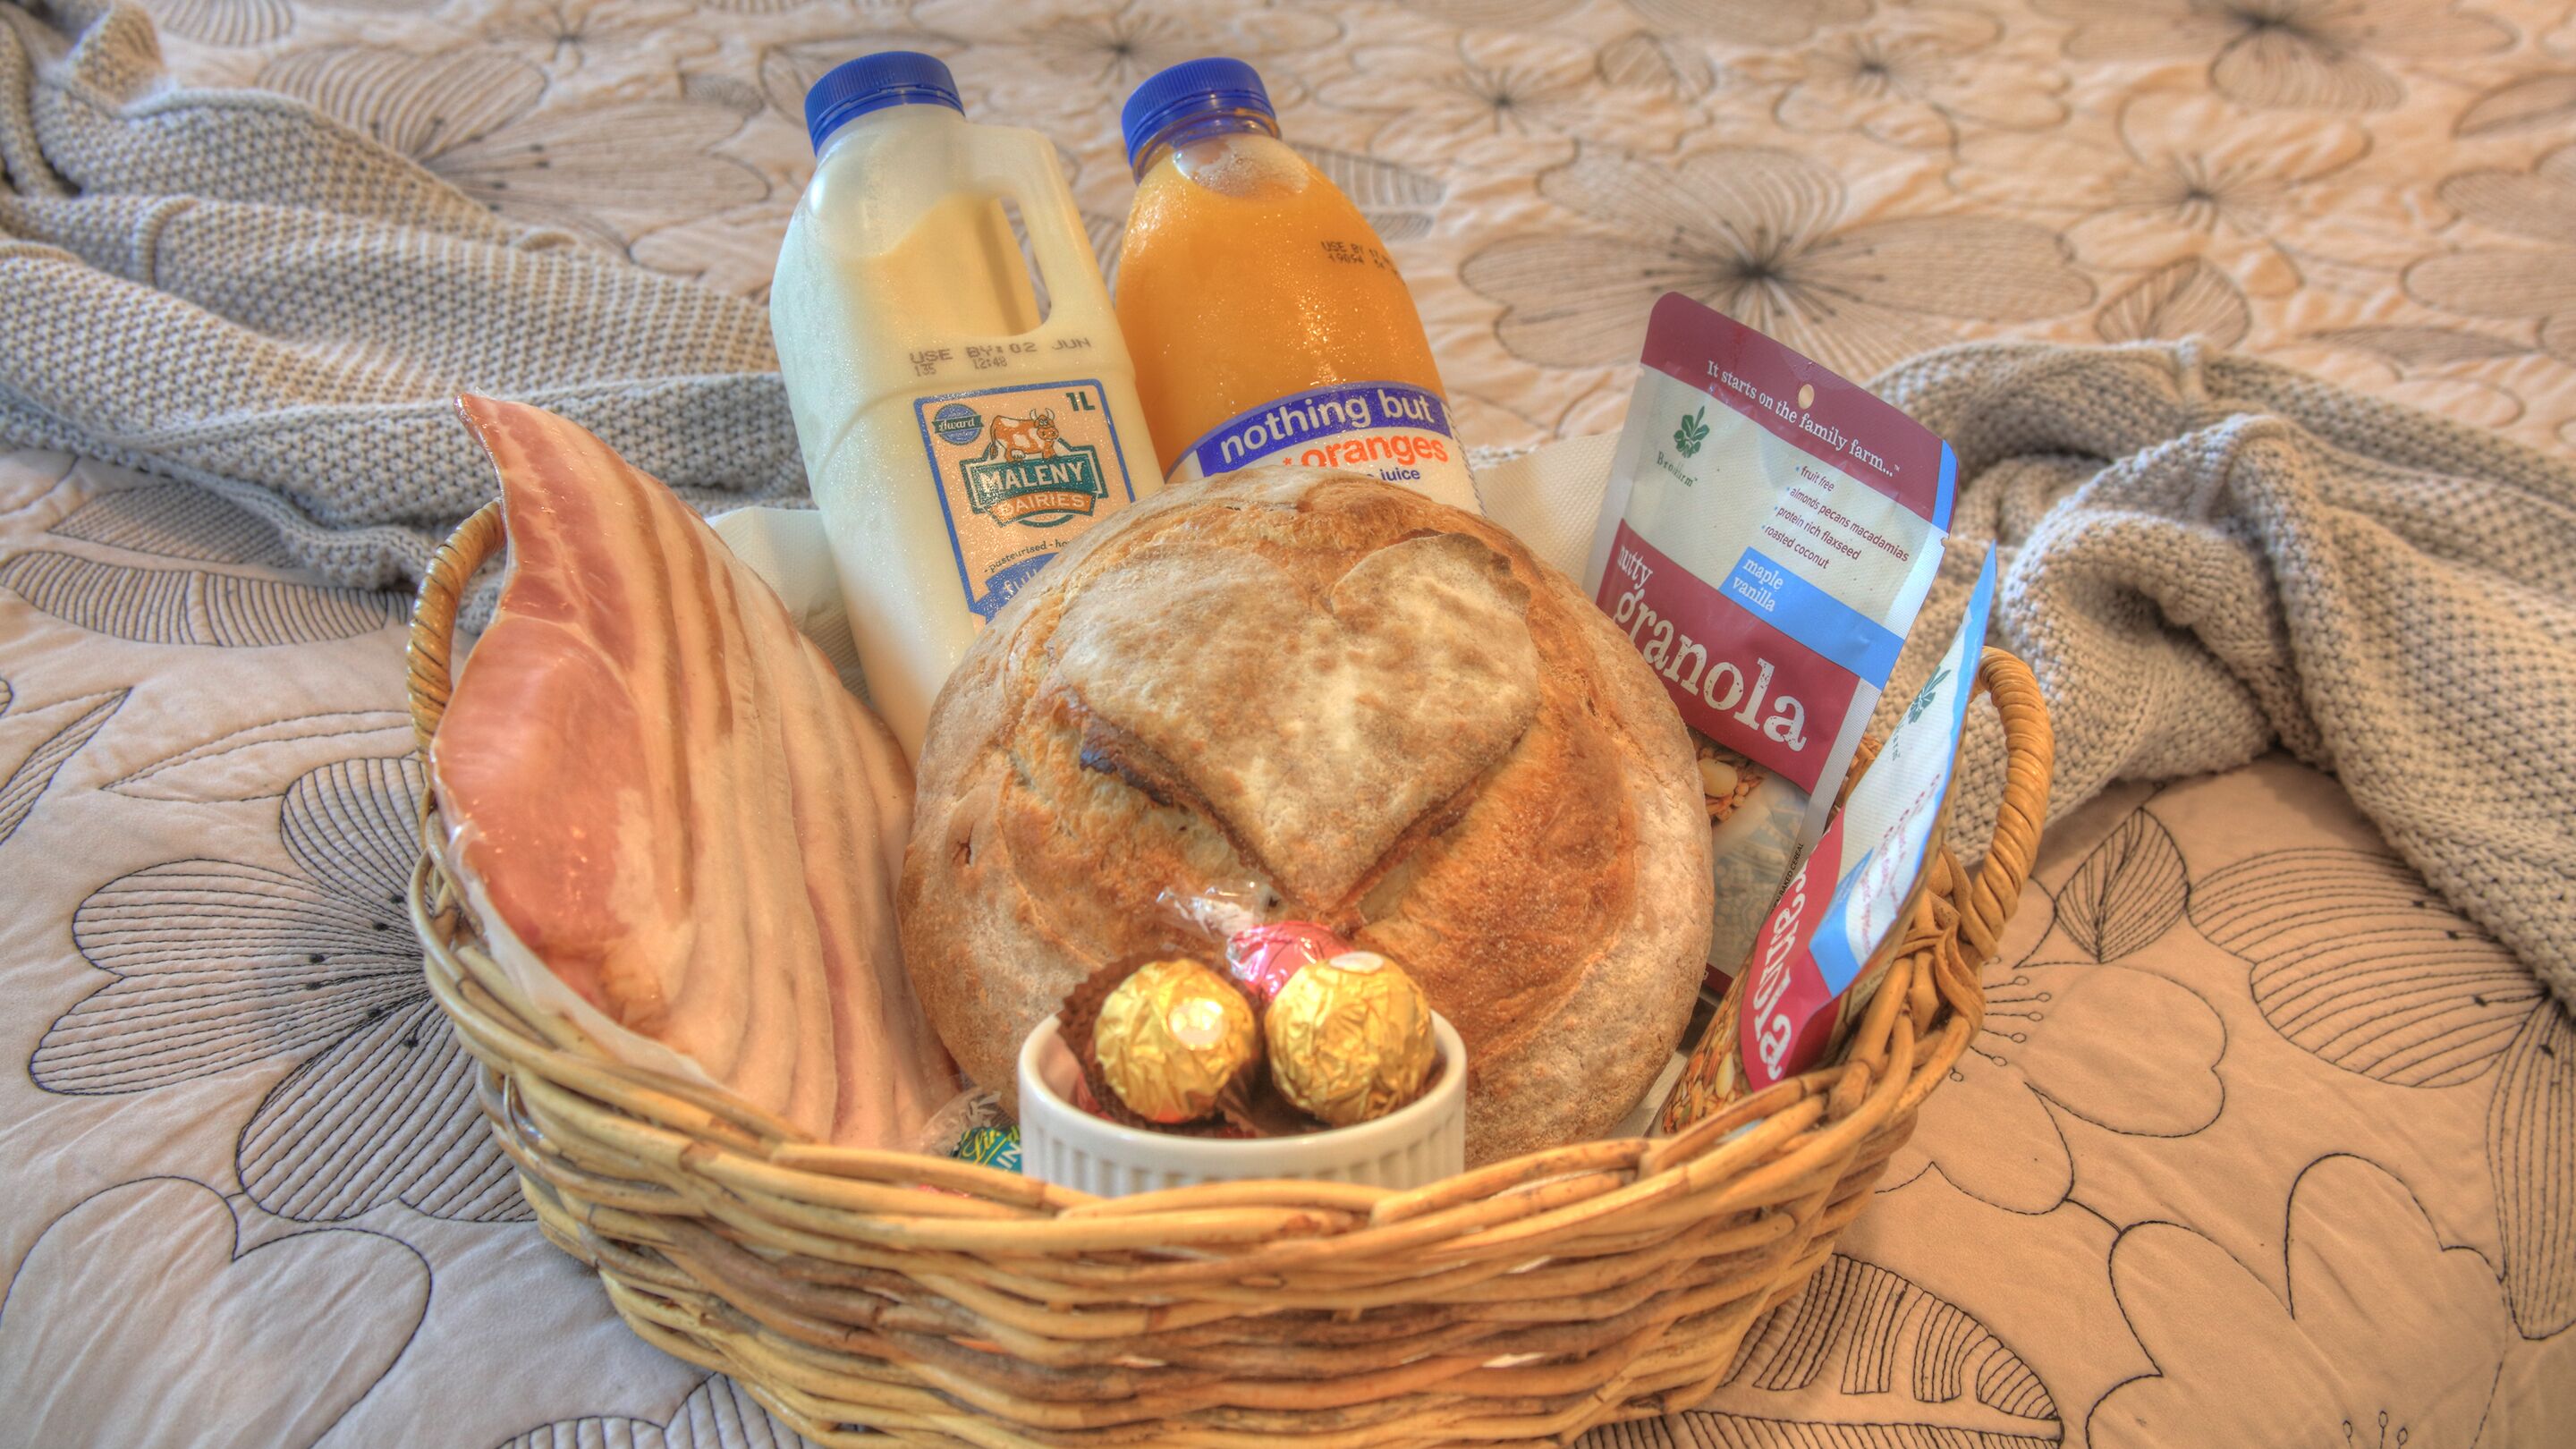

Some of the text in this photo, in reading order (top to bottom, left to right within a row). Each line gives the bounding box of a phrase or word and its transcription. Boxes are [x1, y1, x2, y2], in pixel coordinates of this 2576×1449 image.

[909, 348, 953, 365] USE
[1009, 342, 1038, 354] 02
[1051, 337, 1092, 351] JUN
[1065, 391, 1096, 411] 1L
[1707, 360, 1719, 378] It
[1721, 370, 1758, 400] starts
[1758, 392, 1775, 411] on
[1775, 400, 1798, 424] the
[1799, 412, 1848, 452] family
[938, 417, 975, 432] Award
[1220, 388, 1436, 464] nothing but
[1301, 435, 1449, 468] oranges
[979, 461, 1084, 492] MALENY
[1800, 466, 1835, 492] fruit free
[998, 493, 1086, 518] DAIRIES
[1775, 506, 1862, 561] protein rich flaxseed
[1790, 487, 1910, 563] almonds pecans macadamias
[988, 540, 1047, 573] pasteurised
[1764, 525, 1830, 570] roasted coconut
[1617, 545, 1654, 590] nutty
[1741, 558, 1784, 591] maple
[1733, 577, 1776, 613] vanilla
[1613, 587, 1808, 752] granola
[1779, 870, 1793, 896] BAKED
[1790, 843, 1804, 870] CEREAL
